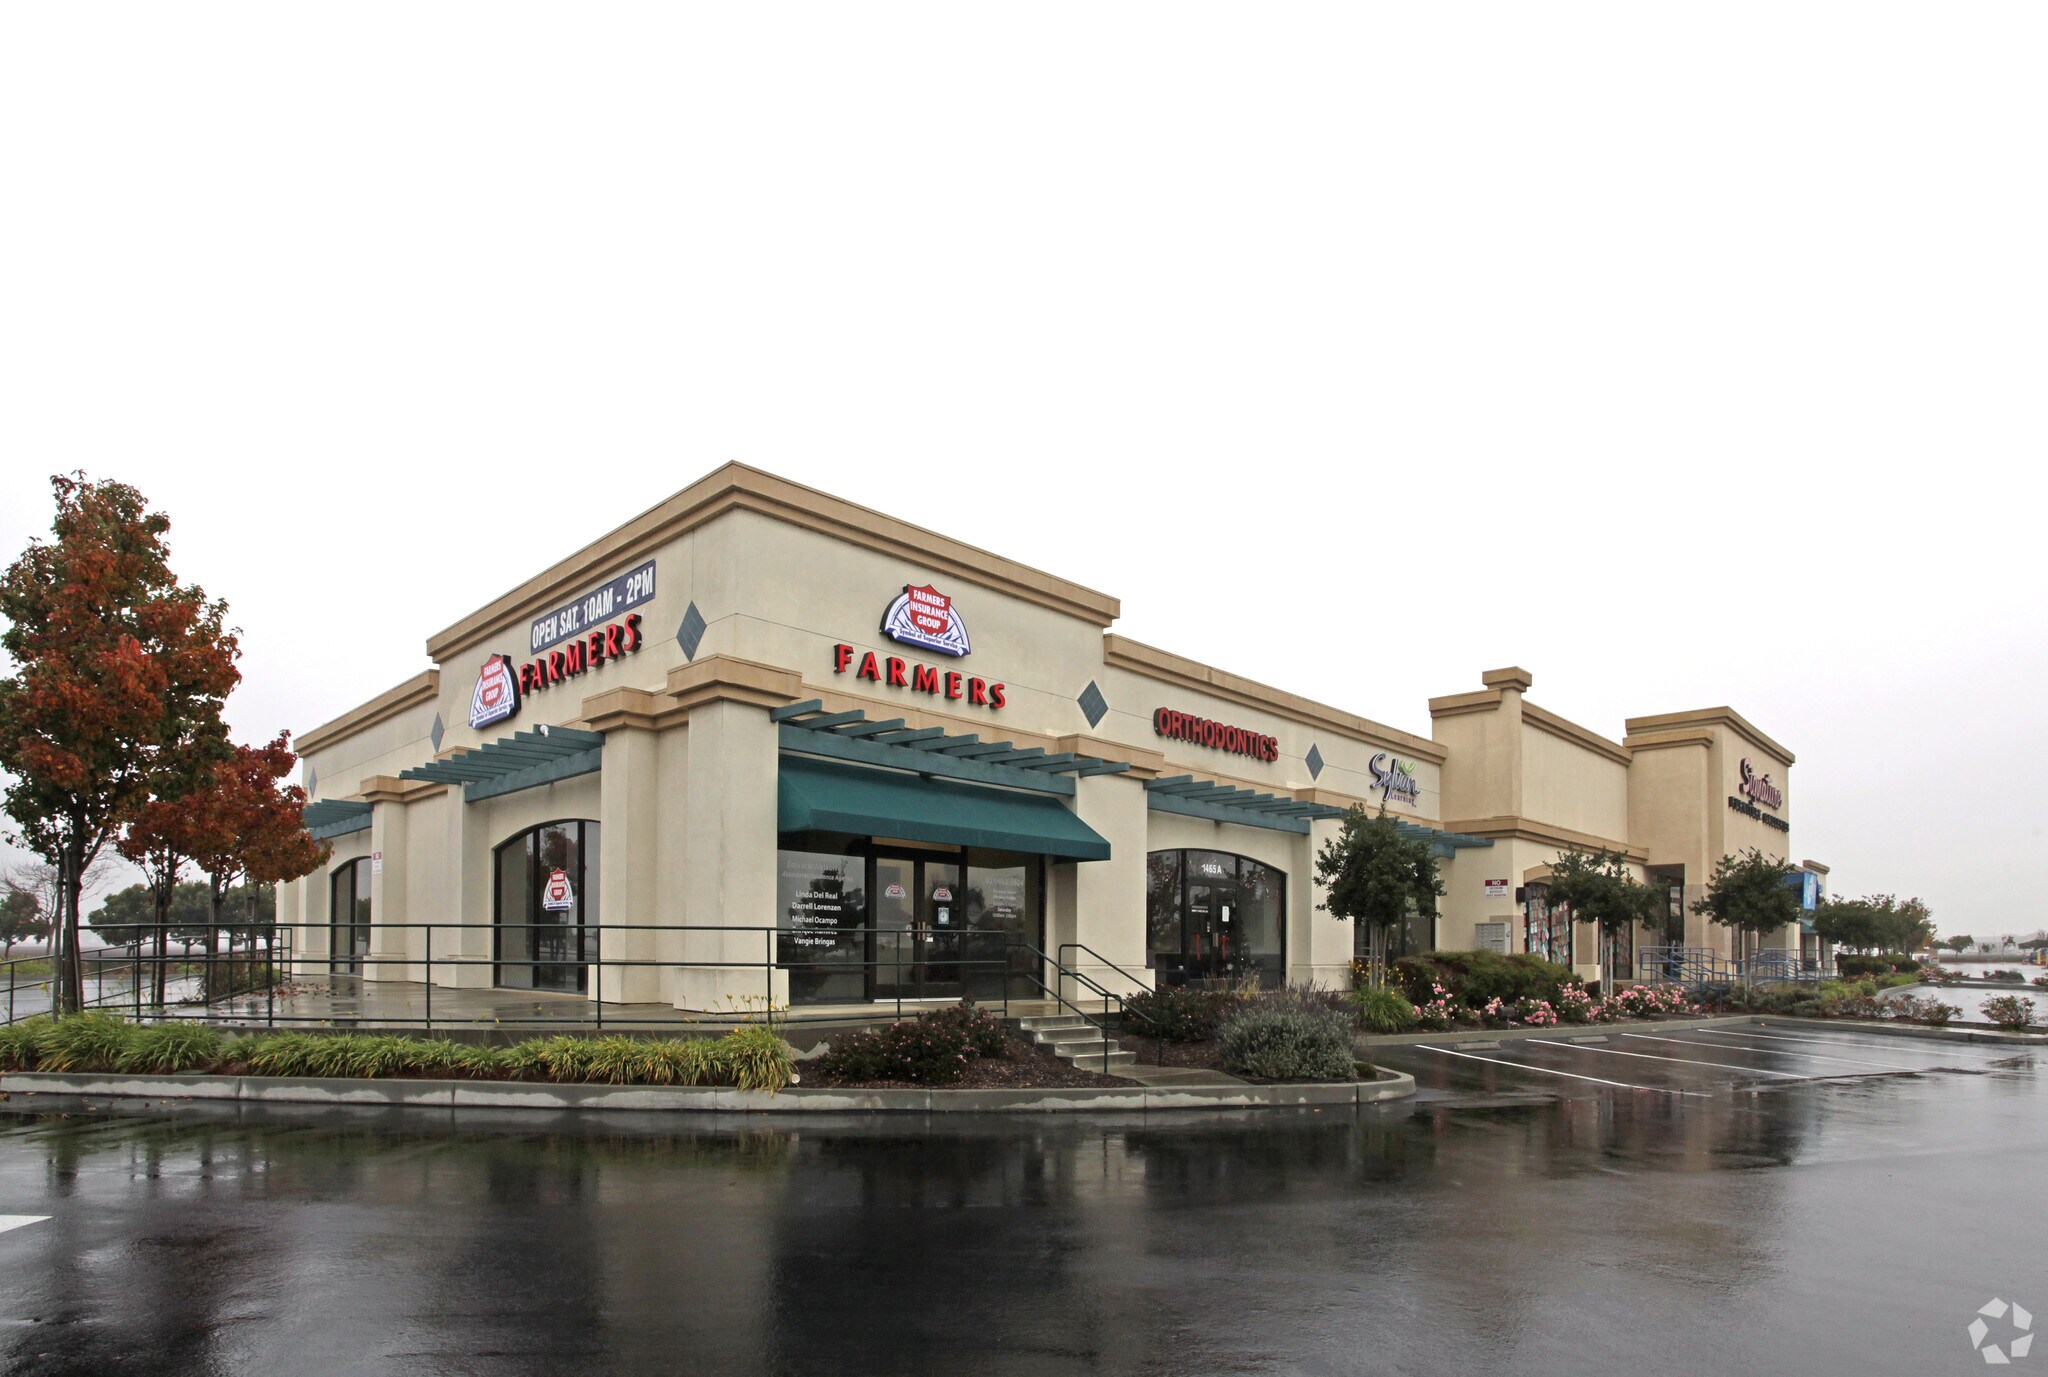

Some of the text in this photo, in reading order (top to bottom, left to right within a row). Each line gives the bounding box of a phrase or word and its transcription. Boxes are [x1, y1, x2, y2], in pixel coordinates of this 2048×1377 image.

[913, 589, 945, 608] FARMERS
[532, 621, 557, 649] OPEN
[560, 604, 580, 636] SAT.
[583, 587, 614, 625] 10AM
[626, 566, 654, 605] 2PM
[910, 600, 949, 621] INSURANCE
[917, 614, 941, 630] GROUP
[519, 613, 642, 696] FARMERS
[484, 660, 502, 677] FARMERS
[835, 643, 1006, 709] FARMERS
[485, 687, 499, 702] GROUP
[1154, 707, 1278, 762] ORTHODONTICS
[1369, 753, 1420, 801] Sylvan
[1201, 864, 1222, 873] 1465 A
[795, 890, 838, 900] Linda Del Real
[792, 901, 841, 911] Darrell Lorenzen
[792, 915, 838, 926] Michael Ocampo
[794, 937, 836, 948] Vangie Bringas
